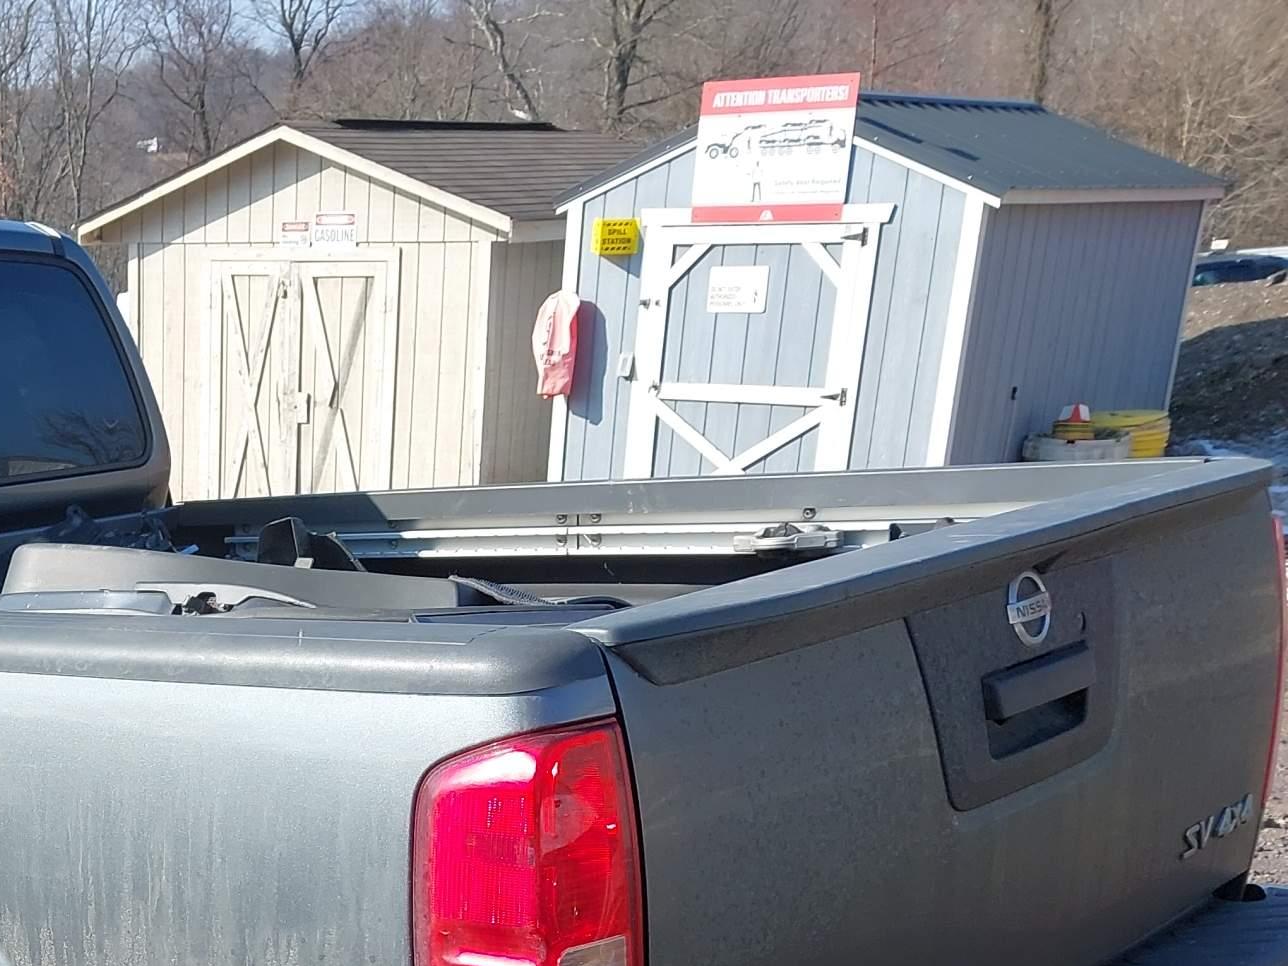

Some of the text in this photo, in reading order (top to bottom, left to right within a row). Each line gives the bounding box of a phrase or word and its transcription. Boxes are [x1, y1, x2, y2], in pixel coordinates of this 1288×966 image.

[713, 85, 851, 109] ATTENTION TRANSPORTERS!
[314, 228, 355, 242] GASOLINE
[607, 228, 626, 236] SPILL
[601, 237, 632, 246] STATION
[1180, 815, 1215, 859] SV
